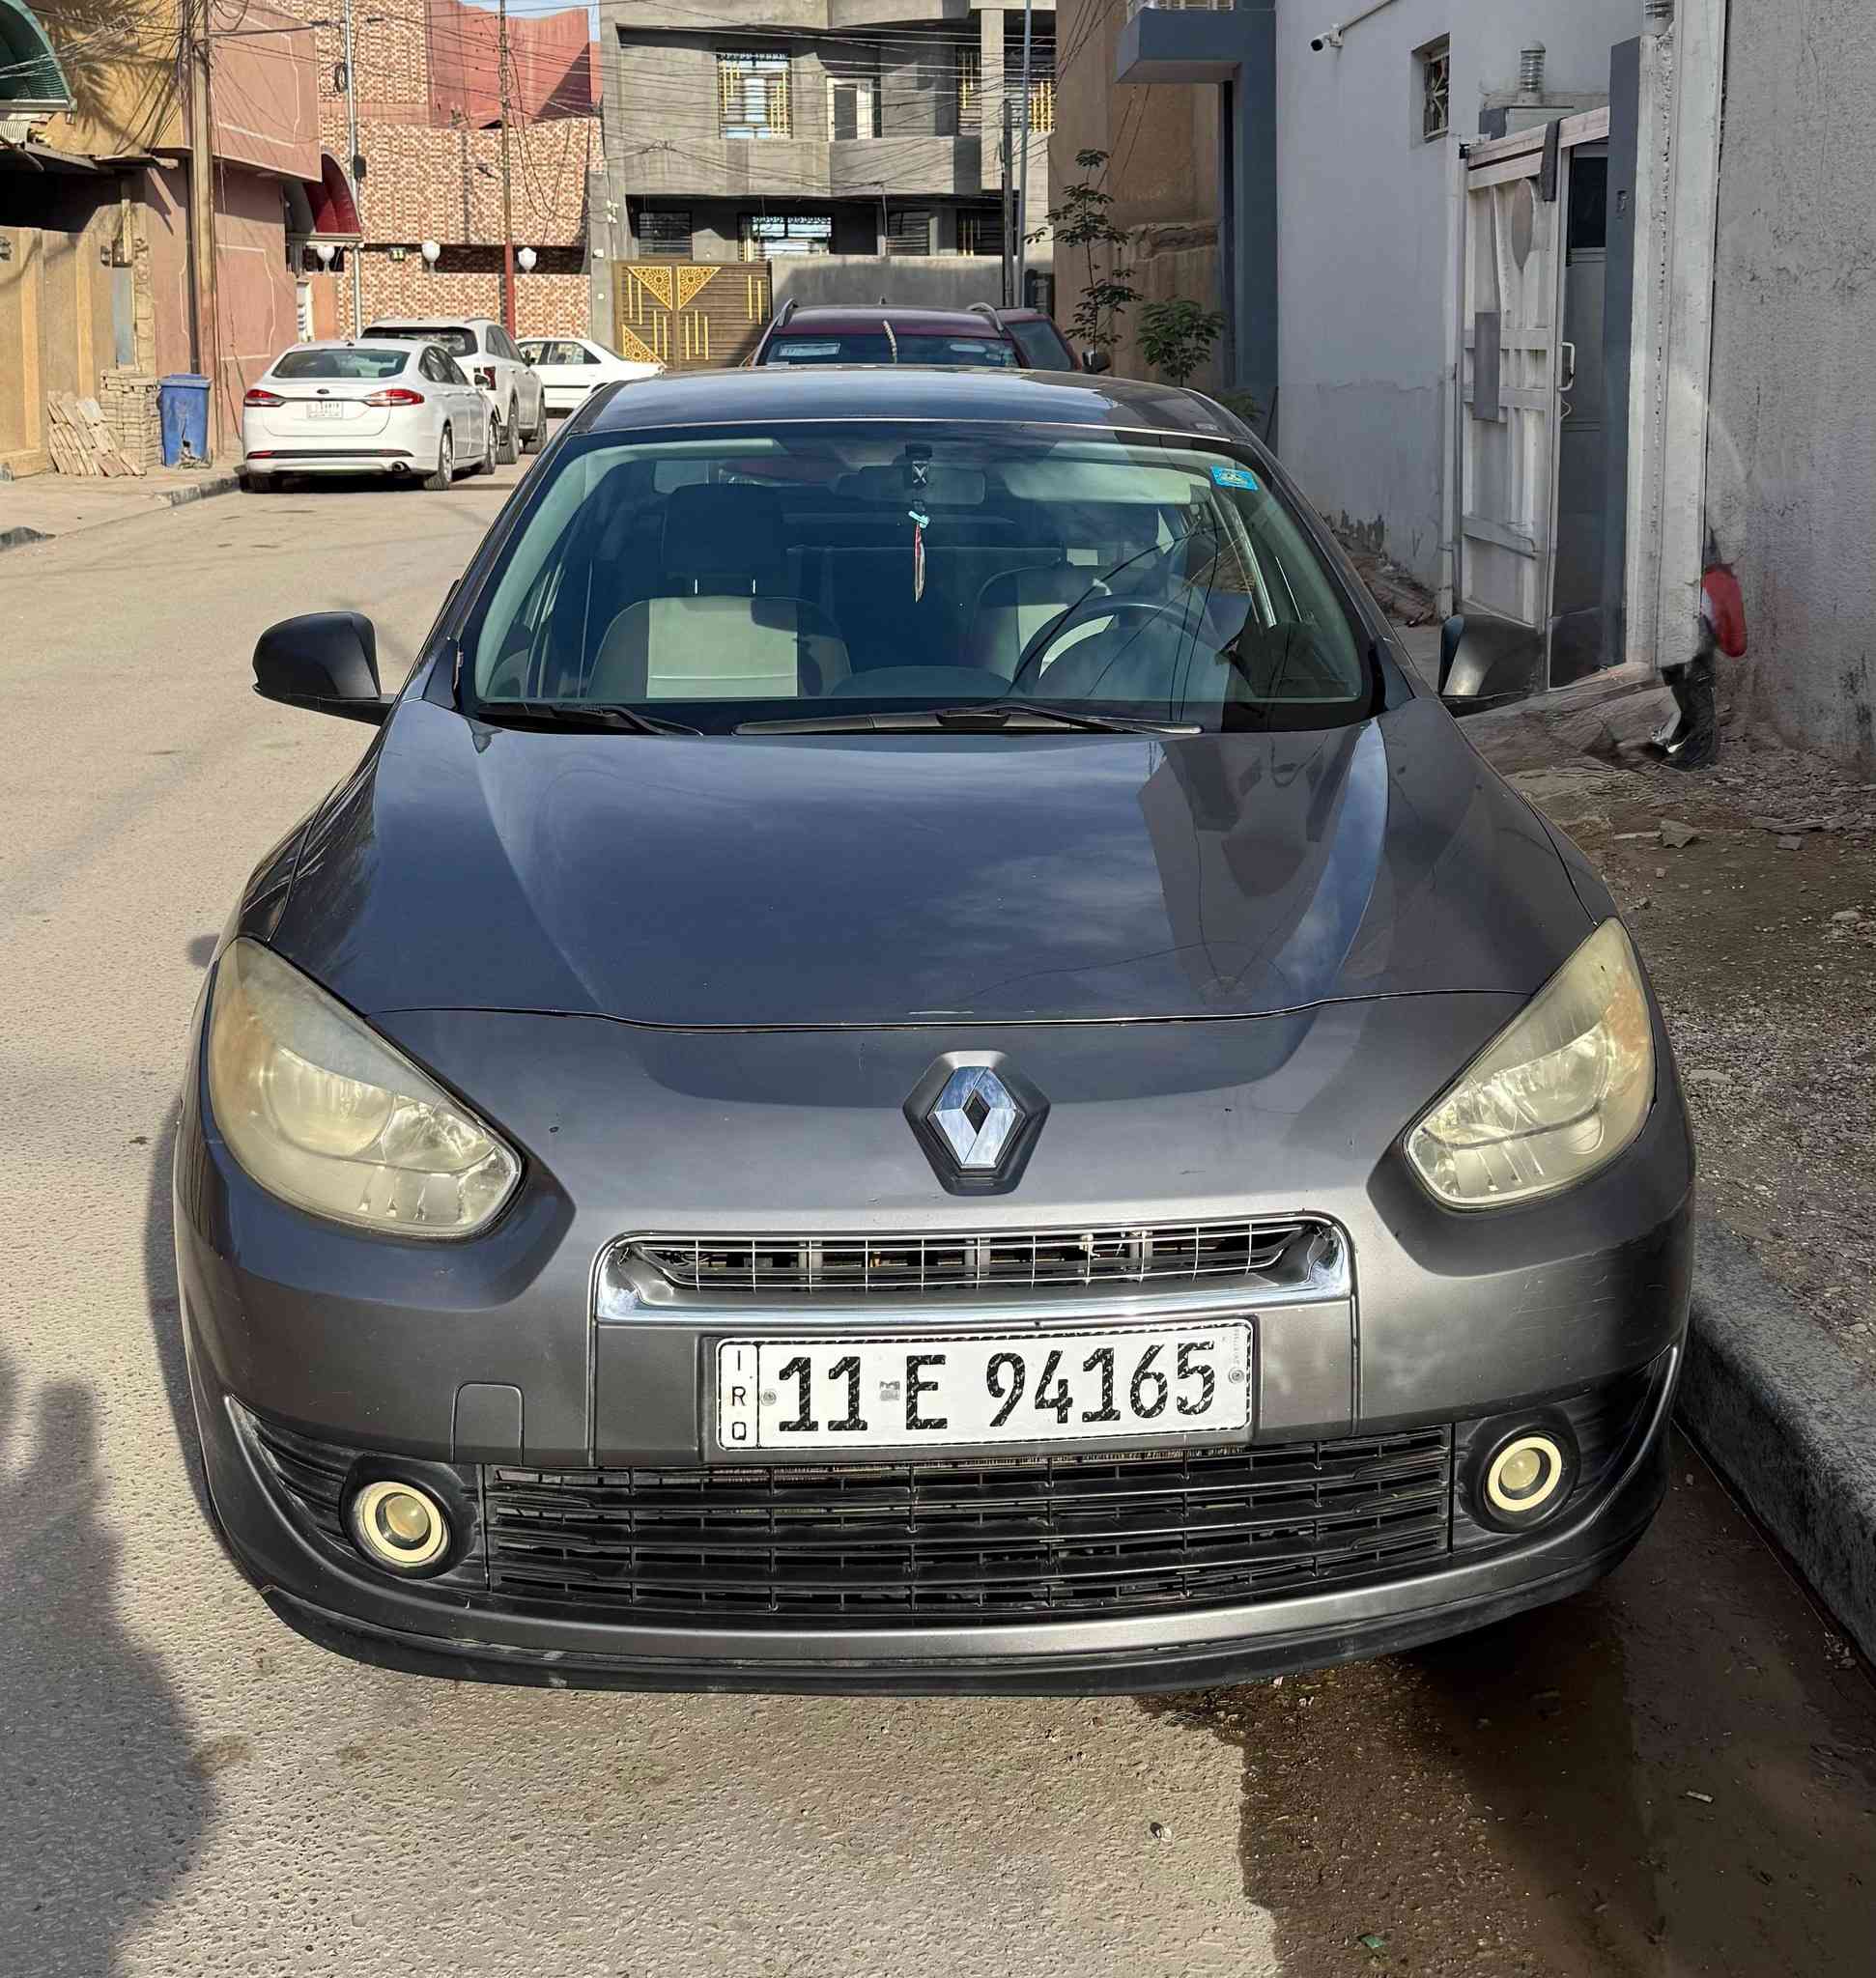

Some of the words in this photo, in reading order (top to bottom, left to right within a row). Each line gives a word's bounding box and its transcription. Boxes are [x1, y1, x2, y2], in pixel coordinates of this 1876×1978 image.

[779, 1356, 868, 1431] 11
[906, 1354, 948, 1429] E
[986, 1341, 1215, 1427] 94165
